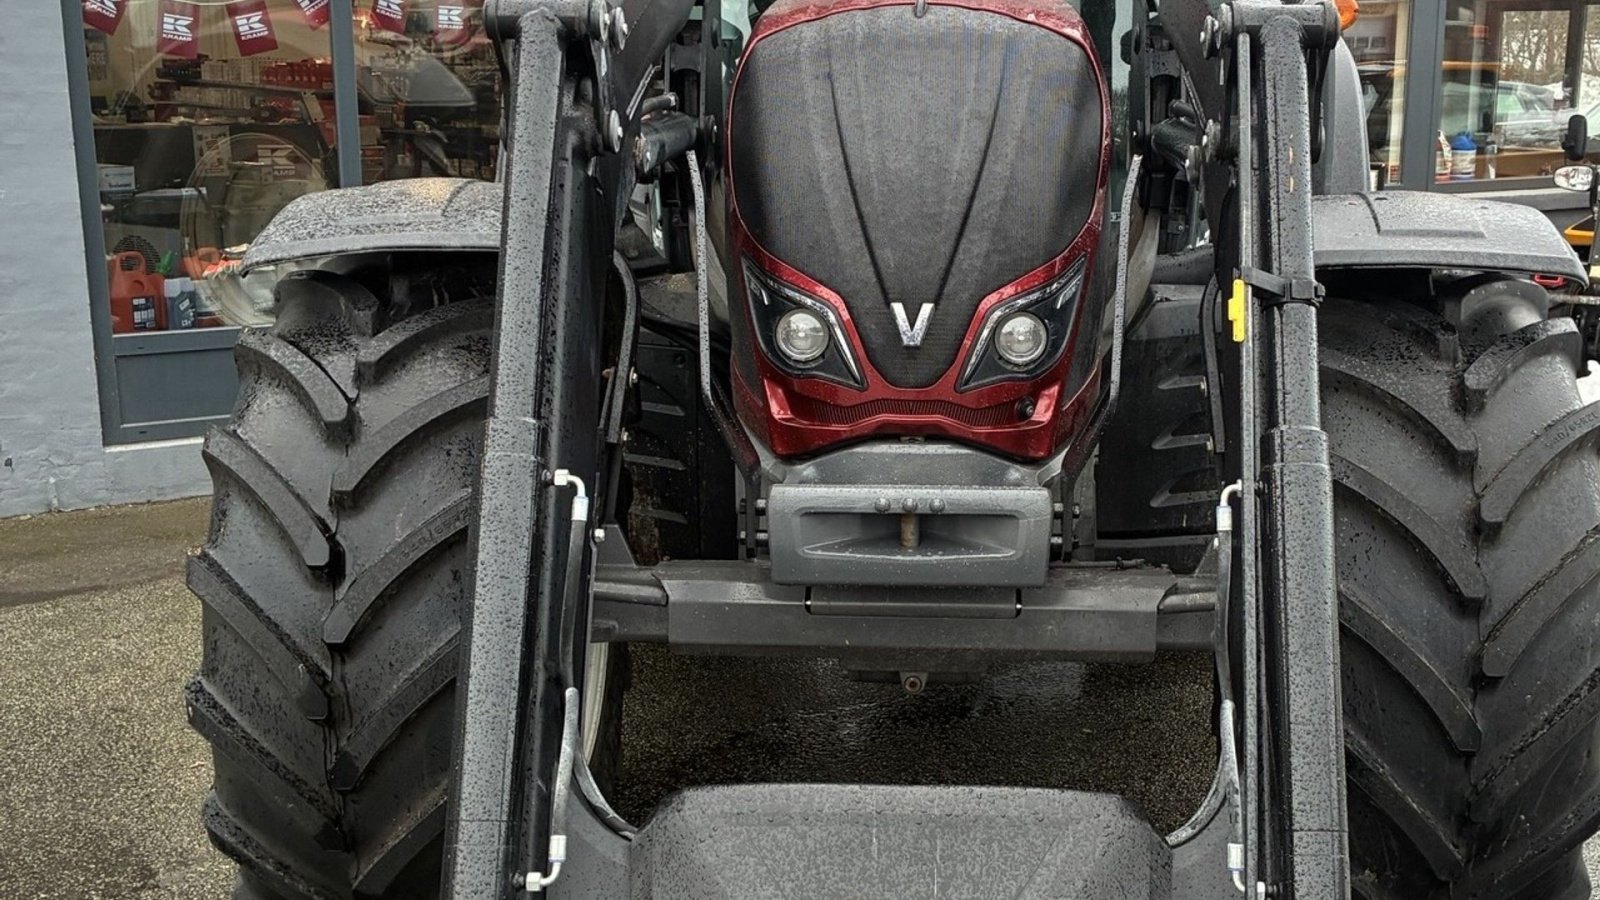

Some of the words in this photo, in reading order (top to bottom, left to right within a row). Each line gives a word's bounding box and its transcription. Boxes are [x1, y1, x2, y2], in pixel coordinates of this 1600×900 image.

[376, 9, 402, 19] KRAMP
[162, 33, 192, 41] KRAMP
[241, 30, 269, 41] KRAMP
[889, 302, 935, 346] V
